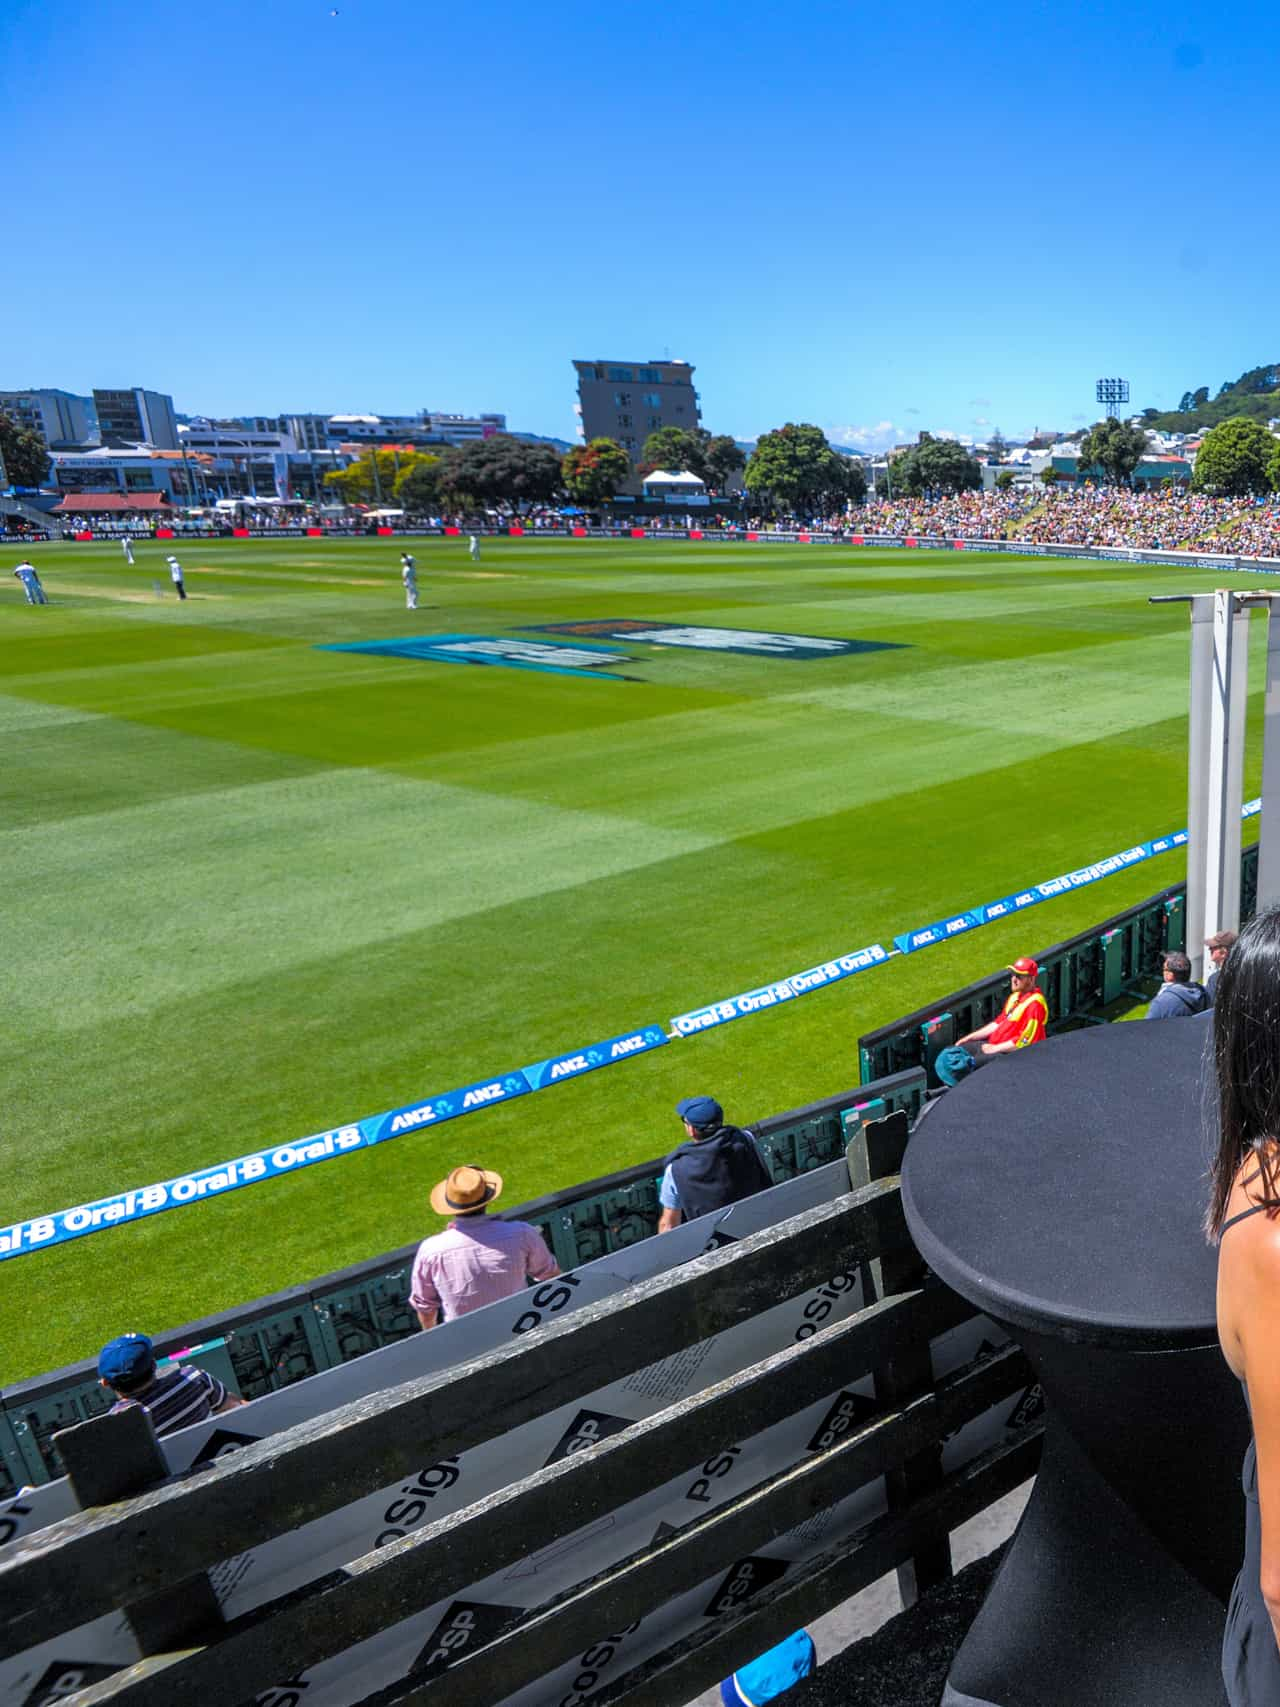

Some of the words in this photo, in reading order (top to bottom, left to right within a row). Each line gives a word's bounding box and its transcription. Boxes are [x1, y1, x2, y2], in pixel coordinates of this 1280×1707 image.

[946, 918, 968, 933] ANZ
[912, 931, 935, 947] ANZ
[611, 1035, 646, 1057] ANZ
[550, 1055, 589, 1078] ANZ
[463, 1082, 505, 1108] ANZ
[391, 1105, 436, 1132] ANZ
[567, 1419, 600, 1455] SP
[717, 1562, 756, 1611] PSP
